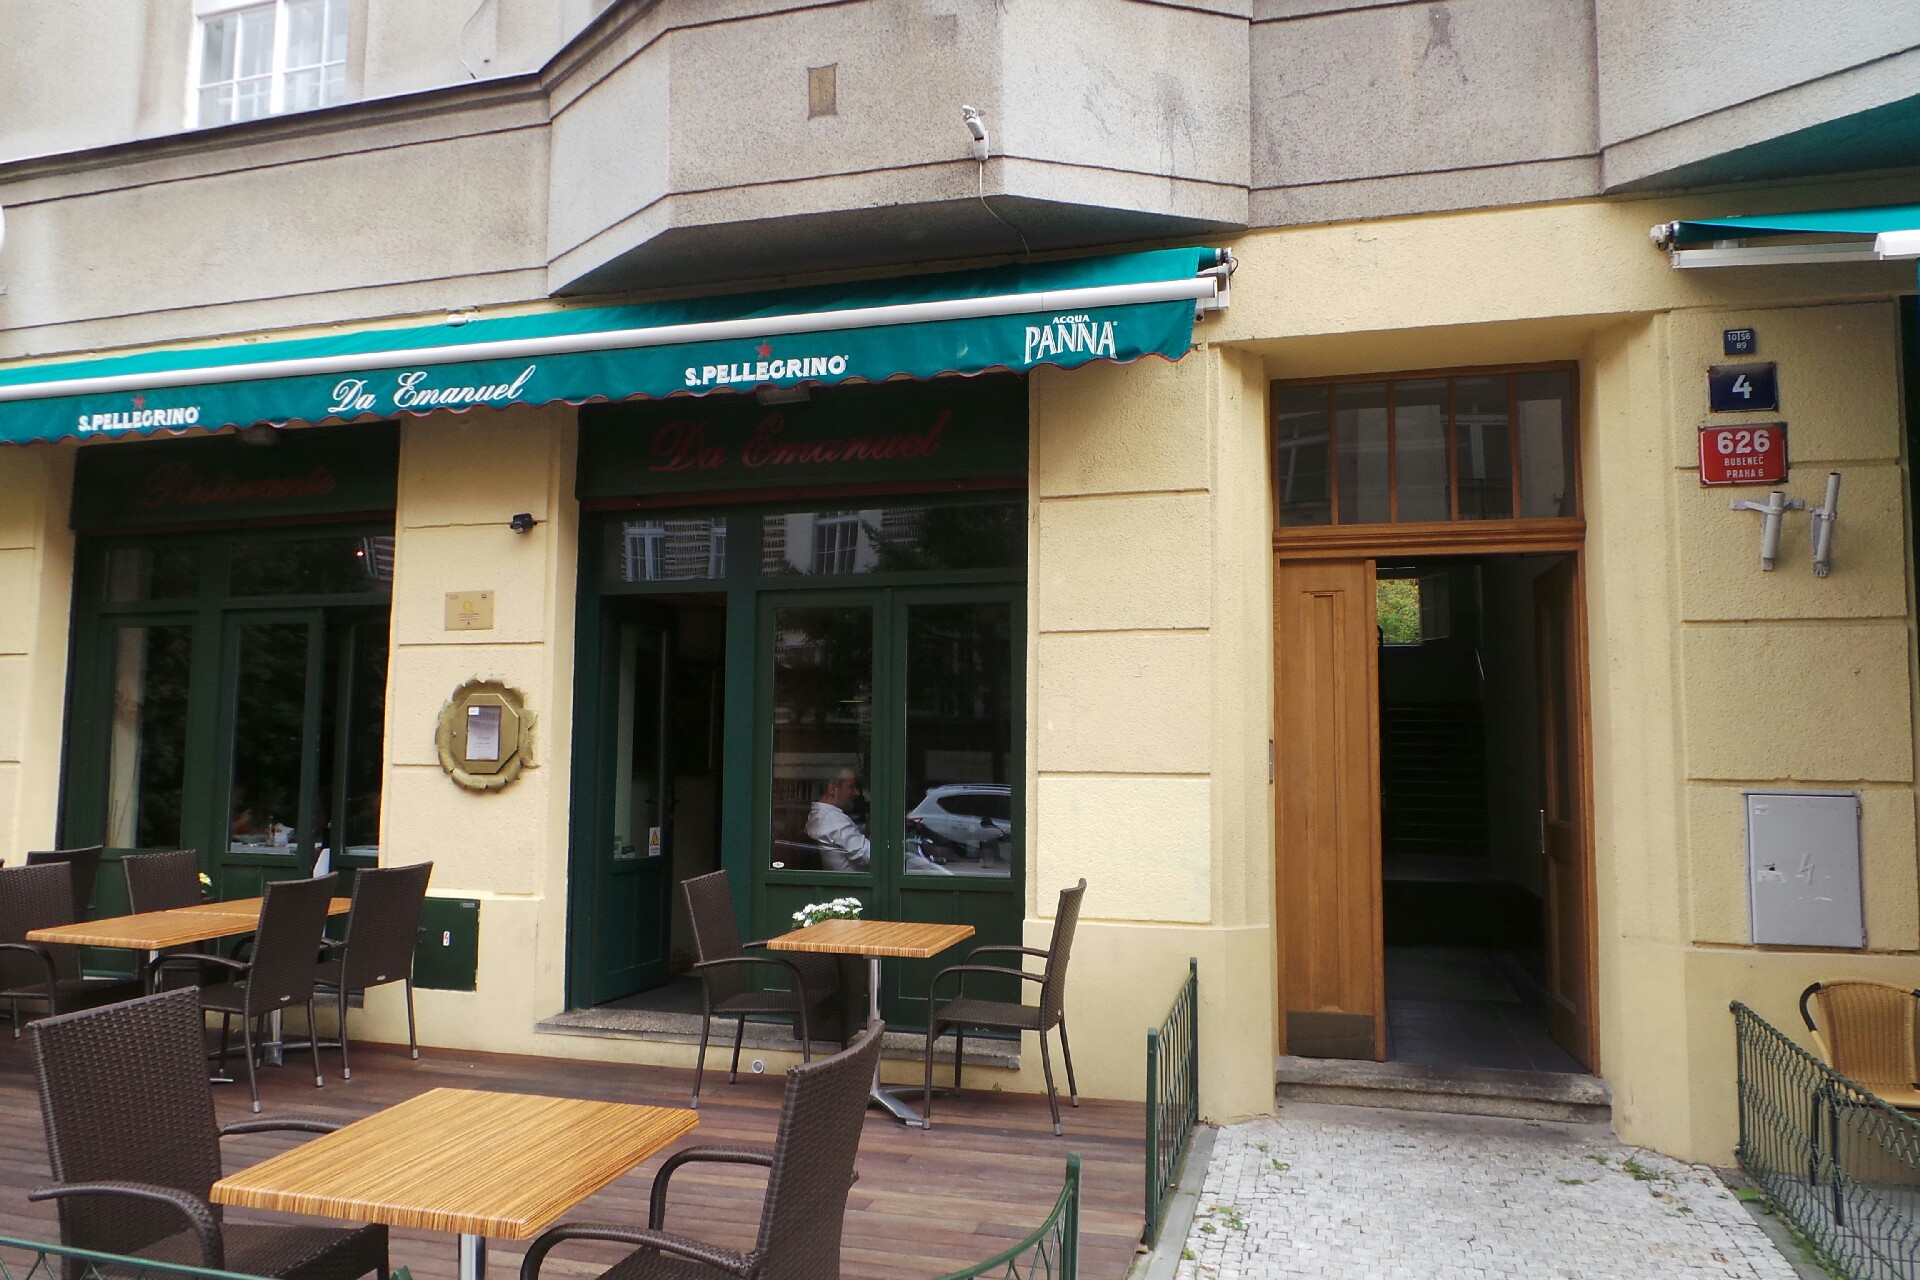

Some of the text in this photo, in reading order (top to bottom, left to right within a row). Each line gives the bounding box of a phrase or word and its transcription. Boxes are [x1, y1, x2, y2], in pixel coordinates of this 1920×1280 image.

[1052, 315, 1090, 324] ACQUA
[1024, 321, 1118, 365] PANNA
[327, 365, 536, 413] Da Emanuel
[1732, 374, 1753, 399] 4
[648, 409, 953, 473] Da Emanuel
[1717, 430, 1771, 455] 626
[1726, 468, 1764, 478] PRAHA 6
